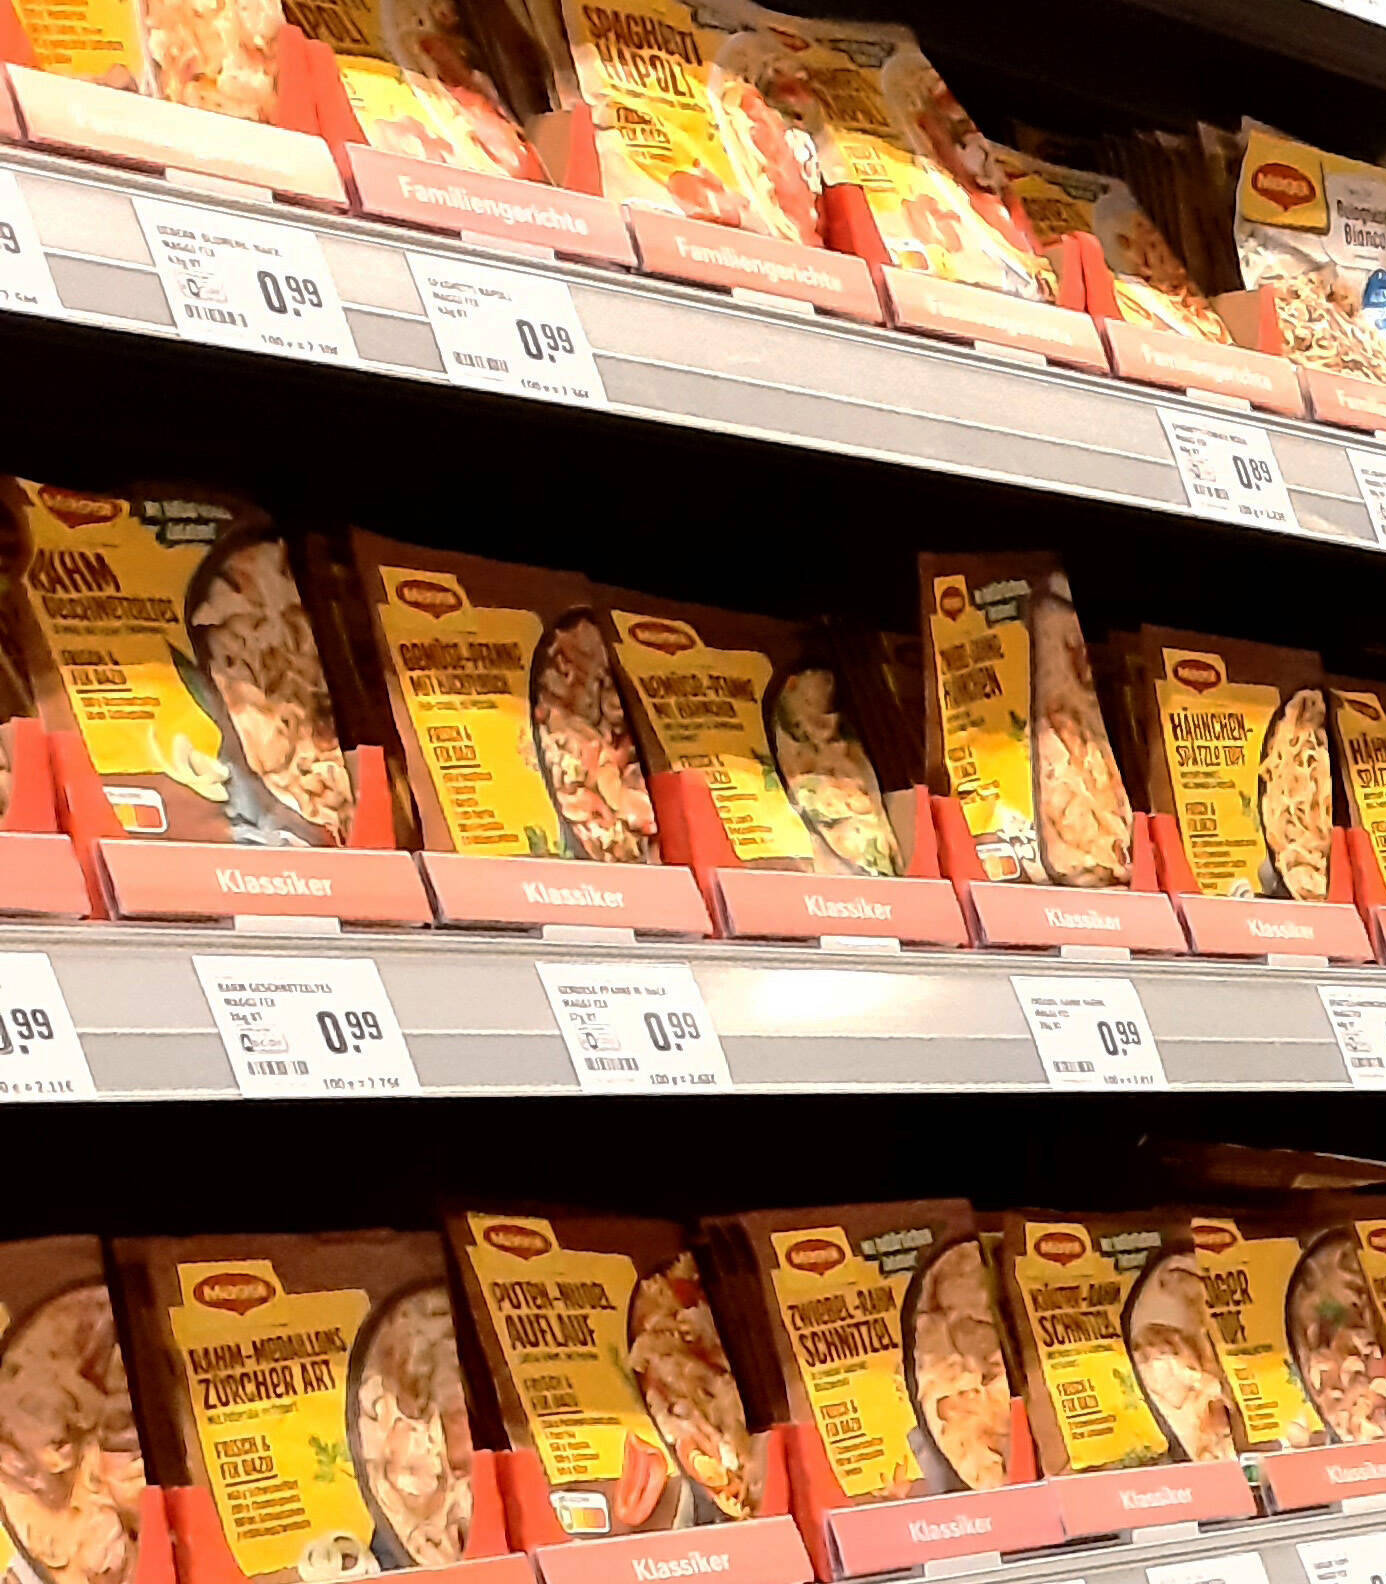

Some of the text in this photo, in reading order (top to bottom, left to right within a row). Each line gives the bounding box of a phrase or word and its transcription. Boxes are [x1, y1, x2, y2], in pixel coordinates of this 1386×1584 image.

[596, 40, 696, 98] NAPOLI
[399, 175, 589, 236] Familiengerichte
[1343, 223, 1386, 250] Bianco
[257, 271, 322, 317] 0.99
[516, 319, 574, 363] 0.99
[1233, 456, 1272, 491] 0.89
[28, 549, 121, 594] RAHM
[1169, 707, 1254, 741] HÄHNCHEN-
[217, 868, 333, 897] Klassiker
[523, 880, 625, 910] Klassiker
[804, 893, 893, 922] Klassiker
[1045, 905, 1122, 932] Klassiker
[1247, 917, 1315, 940] Klassiker
[316, 1011, 383, 1054] 0.99
[644, 1013, 700, 1051] 0.99
[1097, 1021, 1141, 1056] 0.99
[504, 1313, 597, 1350] AUFLAUF
[797, 1319, 899, 1369] SCHNITZEL
[1039, 1310, 1121, 1349] SCHNITZEL
[303, 1360, 336, 1393] ART
[1120, 1485, 1192, 1510] Klassiker
[909, 1515, 990, 1541] Klassiker
[631, 1553, 728, 1582] Klassiker
